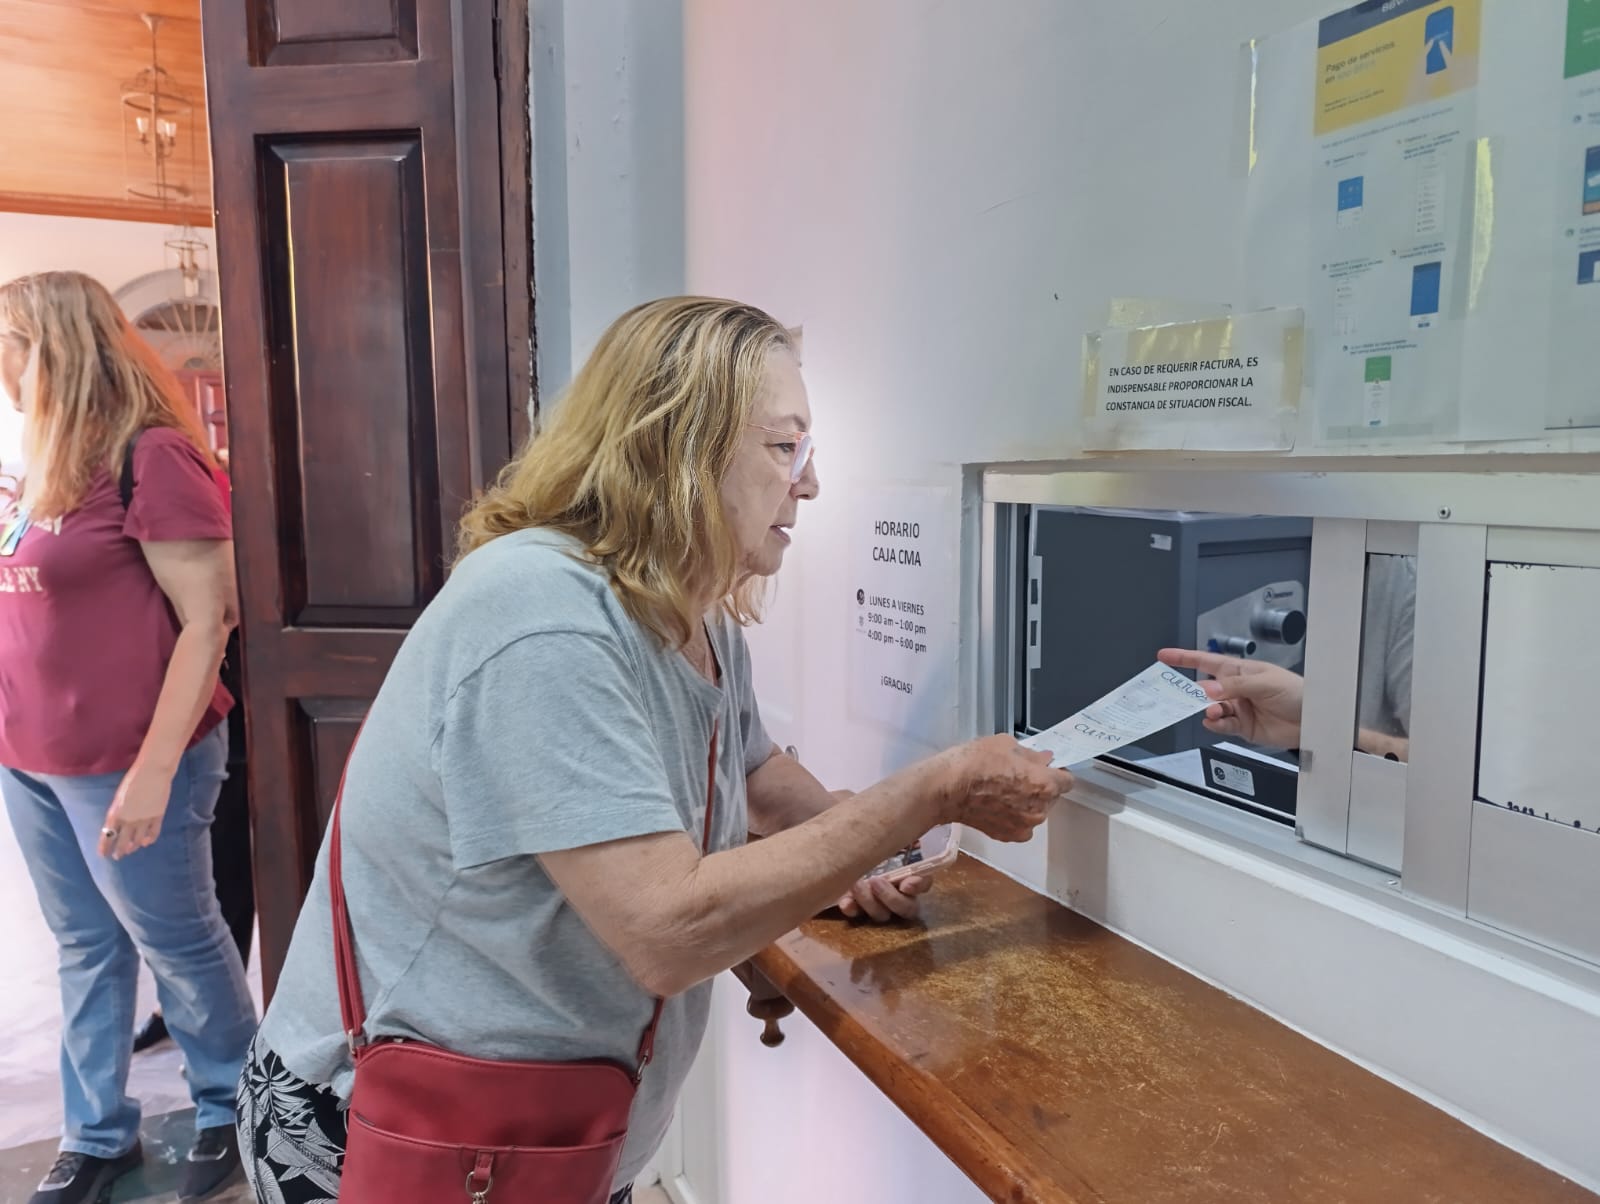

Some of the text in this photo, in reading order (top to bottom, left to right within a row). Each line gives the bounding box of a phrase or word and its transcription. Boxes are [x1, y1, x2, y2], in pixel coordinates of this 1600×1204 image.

[1326, 60, 1345, 73] Pago
[1347, 56, 1358, 65] de
[1359, 41, 1395, 60] servicios
[1109, 356, 1259, 377] EN CASO DE REQUERIR FACTURA, ES
[1107, 376, 1254, 394] INDISPENSABLE PROPORCIONAR LA
[1105, 397, 1252, 411] CONSTANCIA DE SITUACION FISCAL.
[874, 520, 920, 539] HORARIO
[872, 546, 922, 567] CAJA CMA
[869, 595, 925, 616] LUNES A VIERNES
[868, 612, 882, 625] 9:00
[883, 617, 894, 626] am
[914, 624, 927, 636] pm
[867, 629, 882, 642] 4:00
[883, 634, 894, 646] pm
[914, 643, 927, 654] pm
[881, 675, 913, 695] ¡GRACIAS!
